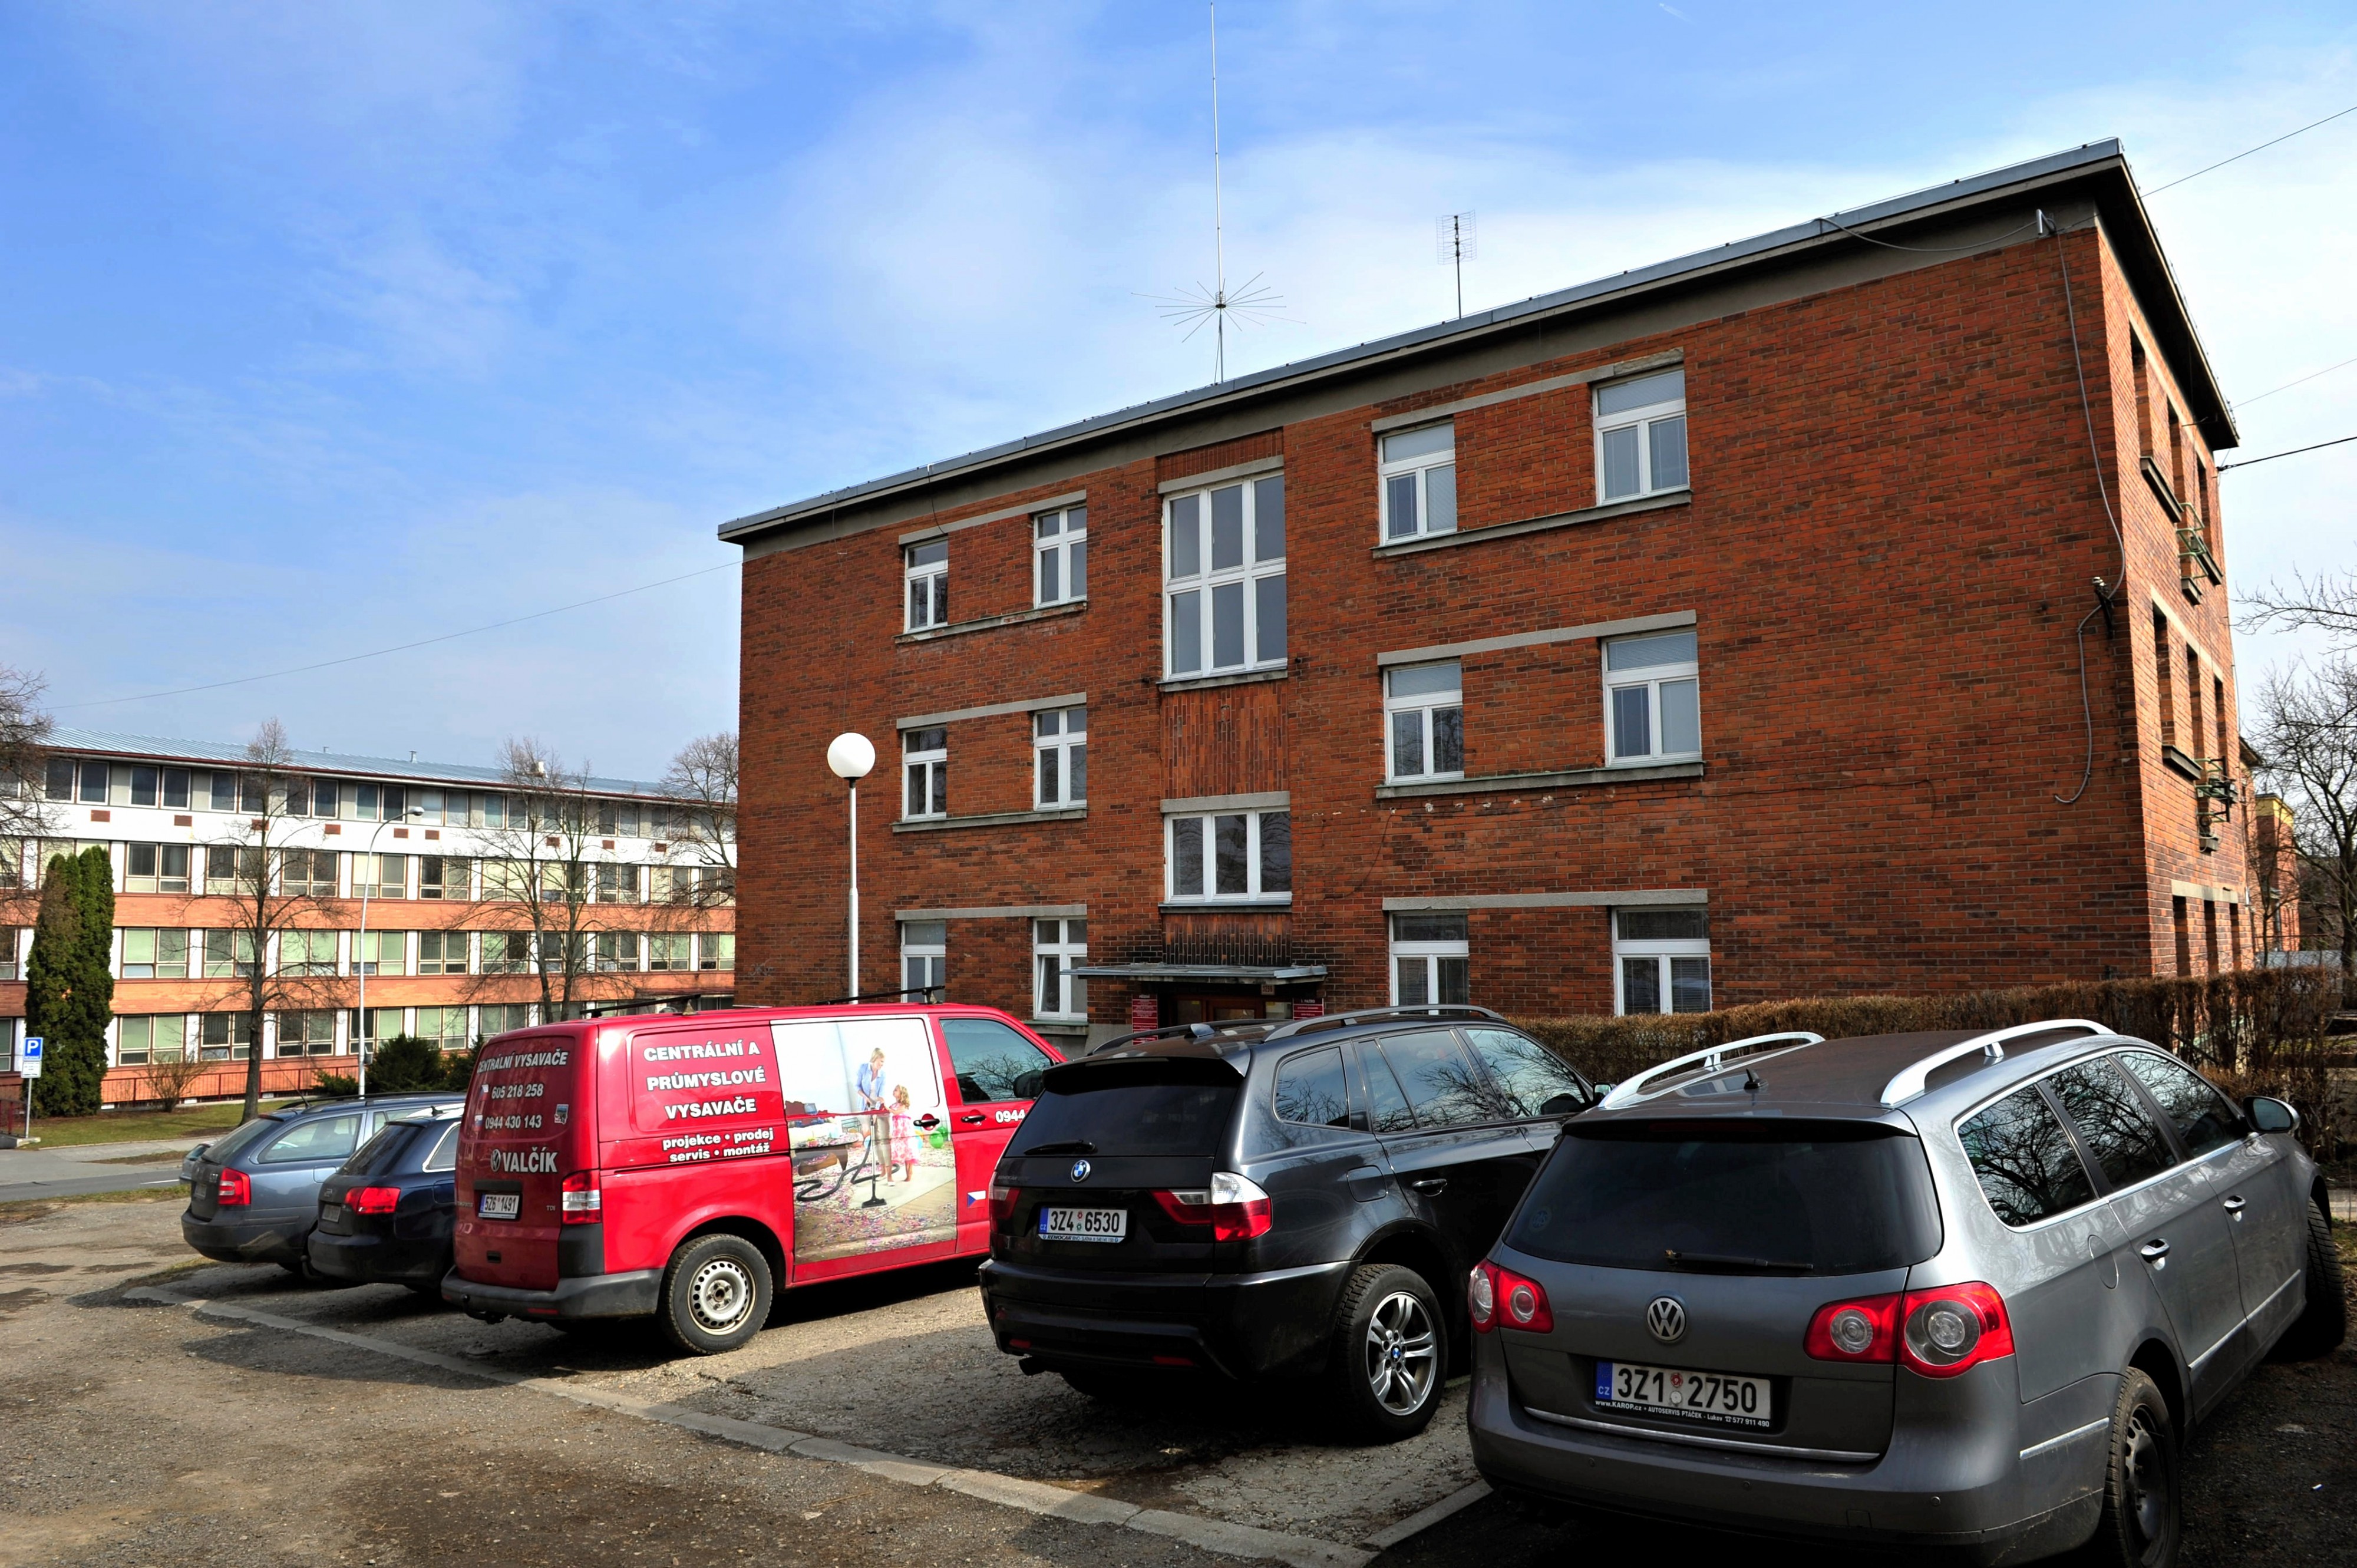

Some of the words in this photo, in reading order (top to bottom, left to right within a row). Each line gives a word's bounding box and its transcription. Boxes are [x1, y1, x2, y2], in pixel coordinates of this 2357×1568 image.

[27, 1040, 39, 1054] P
[643, 1039, 744, 1062] CENTRÁLNÍ
[748, 1042, 760, 1055] A
[477, 1052, 514, 1074] CENTRÁLNÍ
[514, 1048, 569, 1068] VYSAVAČE
[646, 1066, 765, 1091] PRŮMYSLOVÉ
[491, 1086, 505, 1099] 605
[507, 1084, 523, 1098] 218
[524, 1083, 543, 1097] 258
[665, 1096, 756, 1119] VYSAVAČE
[995, 1109, 1025, 1123] 0944
[485, 1117, 503, 1129] 0944
[504, 1115, 521, 1128] 430
[524, 1115, 542, 1128] 143
[663, 1134, 721, 1150] projekce
[734, 1127, 774, 1144] prodej
[503, 1147, 558, 1173] VALČÍK
[670, 1150, 710, 1163] servis
[724, 1142, 770, 1157] montáž
[484, 1196, 497, 1212] 5Z6
[501, 1197, 517, 1212] 1491
[1050, 1211, 1074, 1231] 3Z4
[1085, 1212, 1120, 1233] 6530
[1598, 1386, 1610, 1395] CZ
[1617, 1368, 1664, 1402] 3Z1
[1688, 1376, 1757, 1414] 2750
[1595, 1400, 1642, 1411] www.KAROP.cz
[1648, 1406, 1680, 1416] AUTOSERVIS
[1682, 1410, 1702, 1418] PTÁČEK
